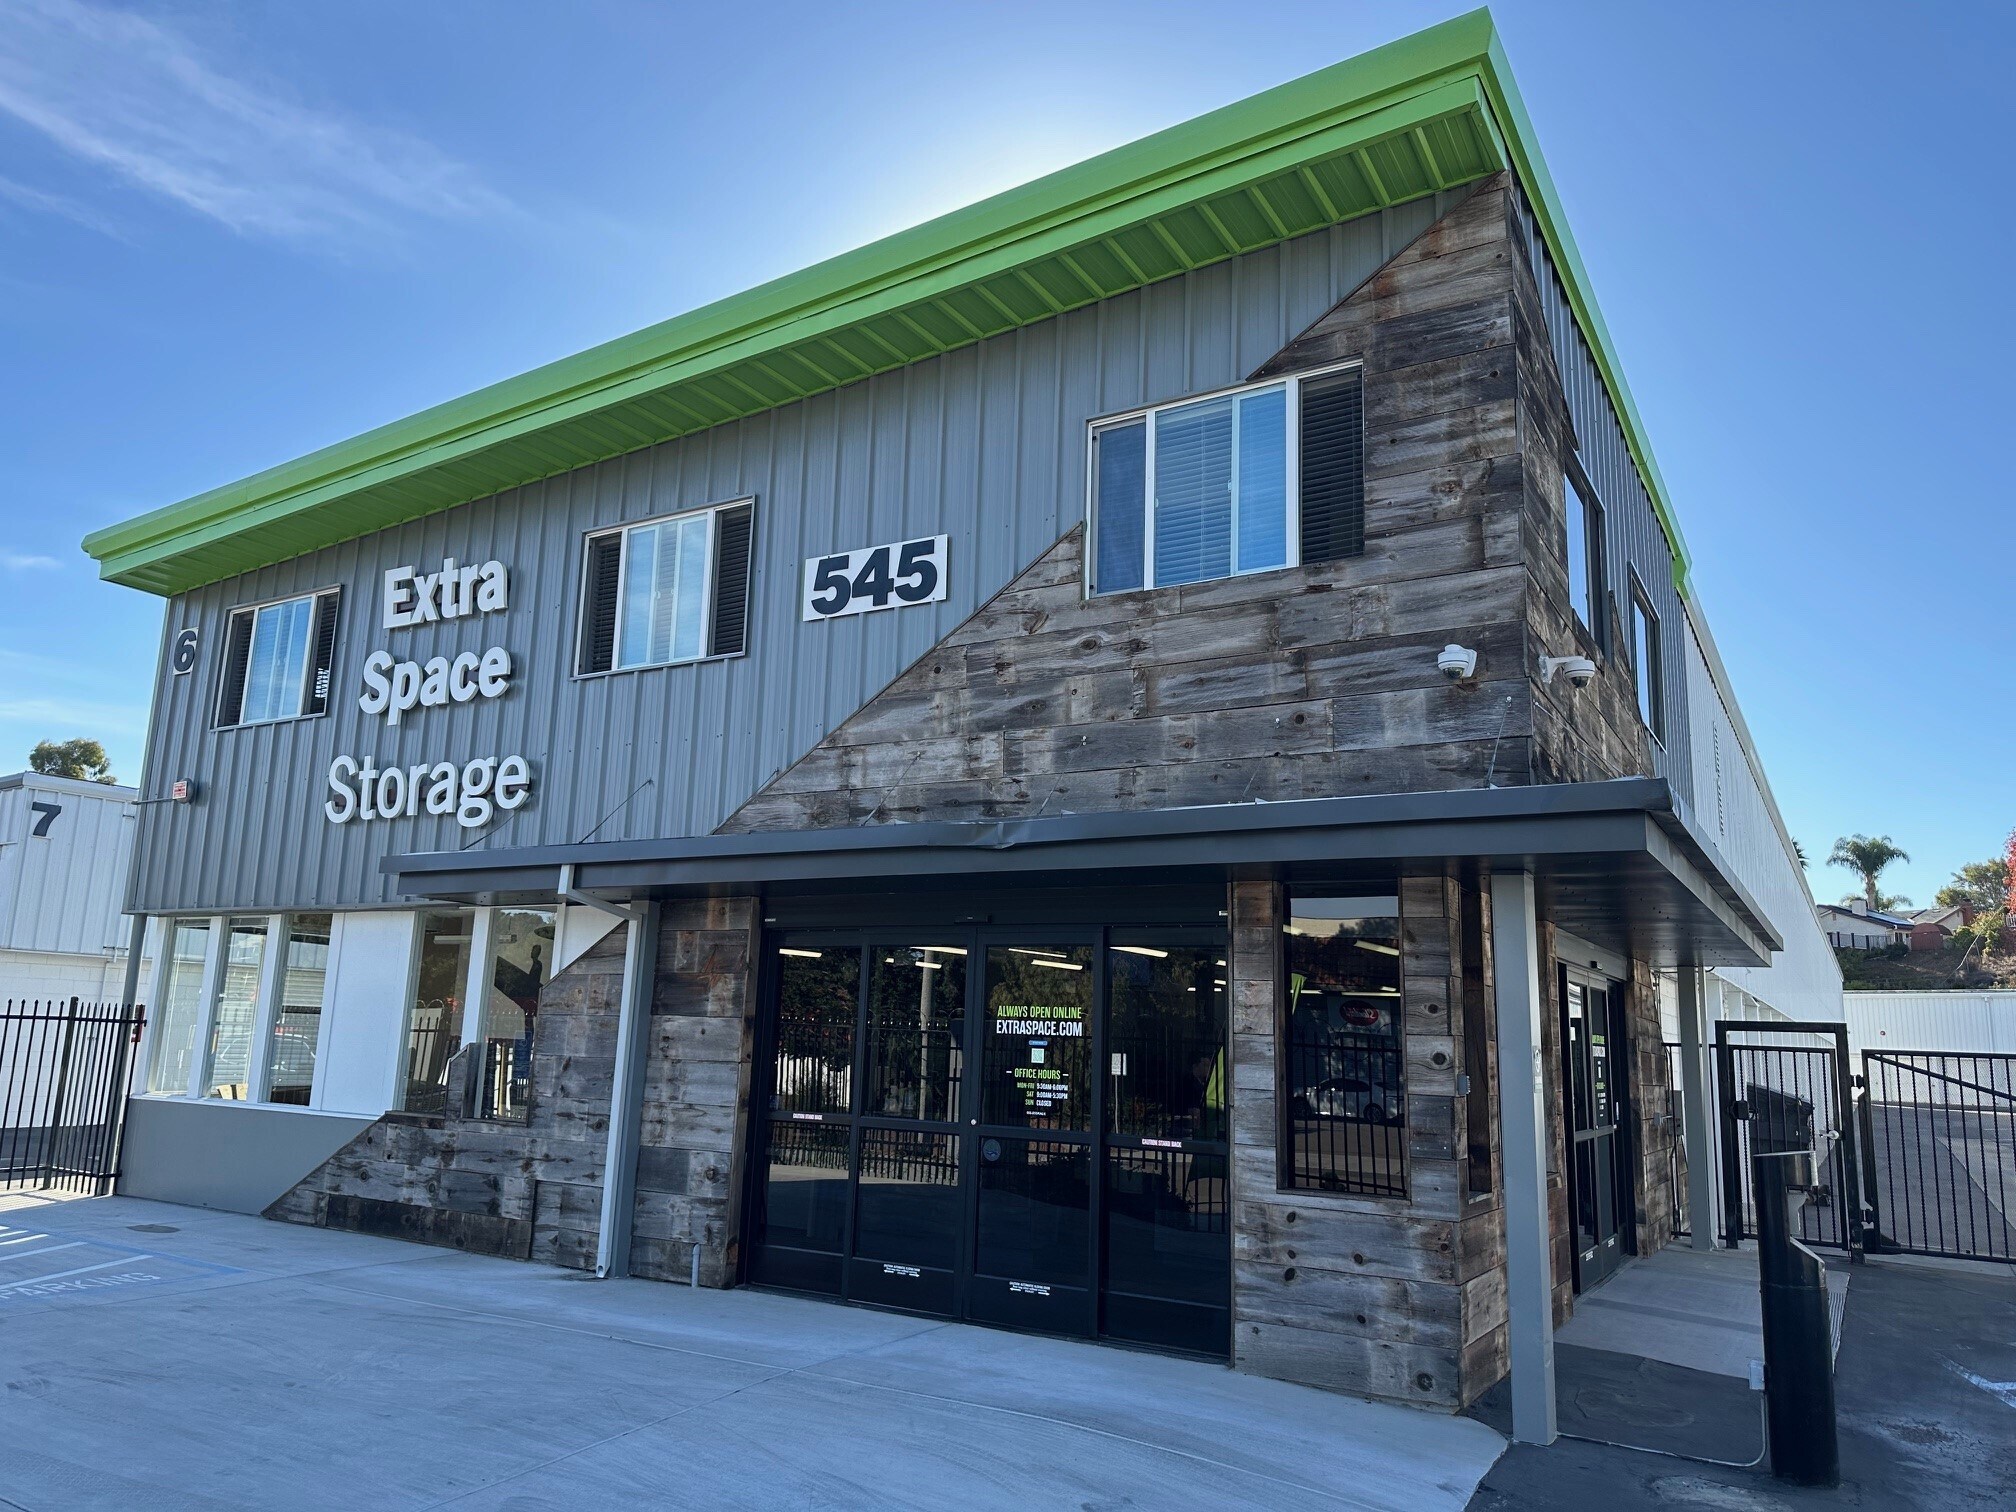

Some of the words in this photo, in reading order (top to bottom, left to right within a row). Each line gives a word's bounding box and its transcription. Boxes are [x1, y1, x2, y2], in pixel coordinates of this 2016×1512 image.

[383, 557, 508, 629] Extra
[811, 539, 938, 615] 545
[173, 630, 197, 673] 6
[359, 646, 511, 726] Space
[325, 754, 530, 828] Storage
[31, 801, 62, 837] 7
[996, 1020, 1083, 1037] EXTRASPACE.COM
[997, 1005, 1028, 1018] ALWAYS
[1030, 1006, 1051, 1019] OPEN
[1053, 1007, 1082, 1019] ONLINE
[1014, 1068, 1037, 1079] OFFICE
[1037, 1070, 1061, 1080] HOURS
